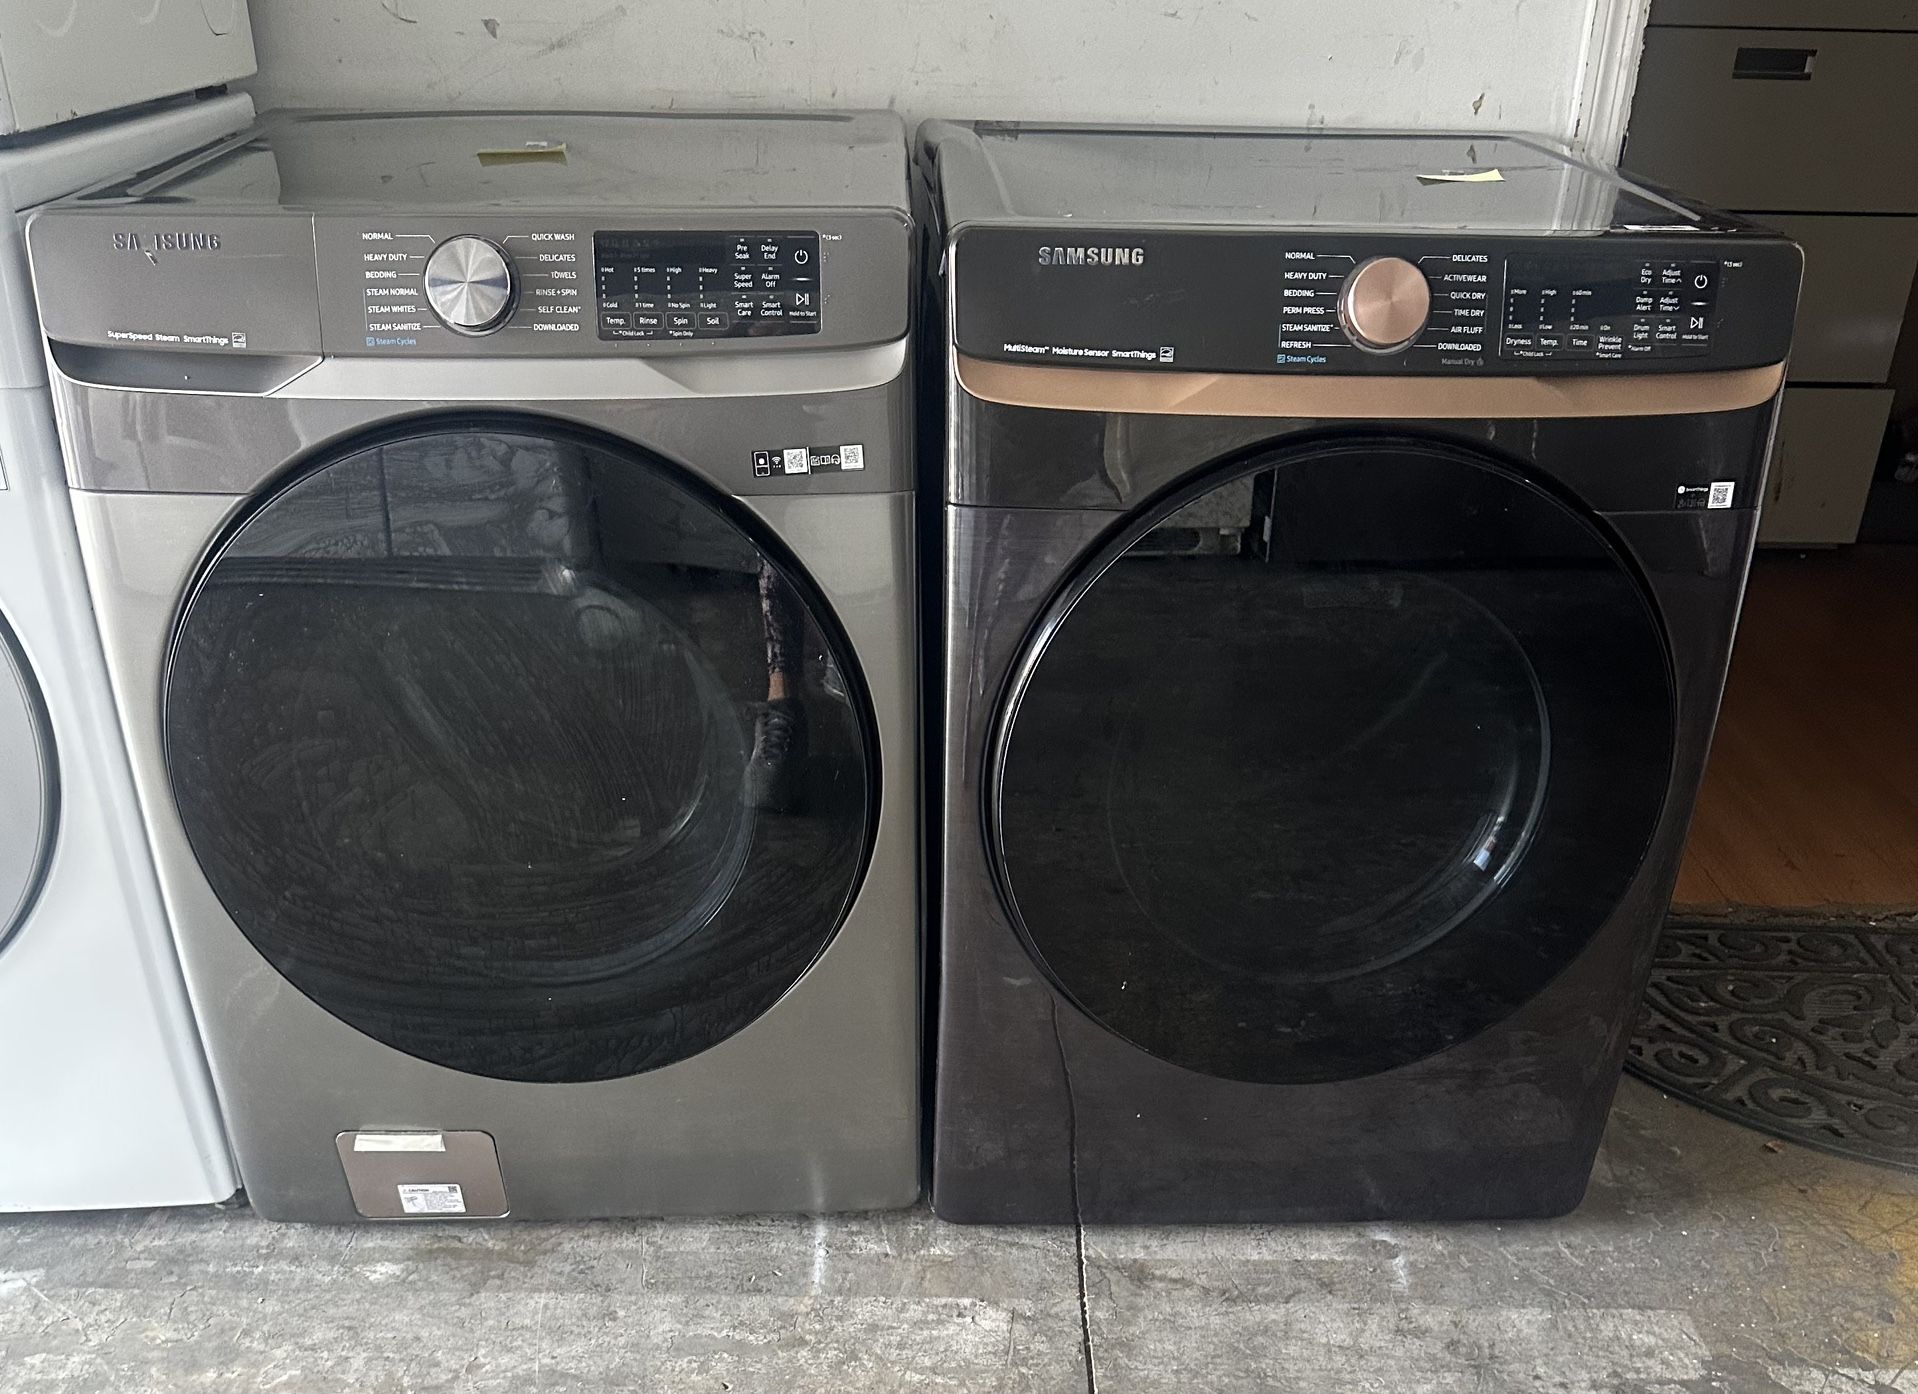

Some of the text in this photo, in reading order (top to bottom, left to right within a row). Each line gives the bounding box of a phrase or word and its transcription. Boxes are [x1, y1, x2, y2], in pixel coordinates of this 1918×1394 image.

[362, 232, 393, 240] NORMAL
[531, 233, 575, 242] QUICK WASH
[761, 244, 779, 253] Delay
[363, 253, 408, 261] HEAVY DUTY
[539, 254, 576, 262] DELICATES
[734, 252, 750, 260] Soak
[763, 252, 776, 260] End
[1037, 246, 1145, 266] SAMSUNG
[1284, 252, 1315, 260] NORMAL
[1452, 254, 1489, 263] DELICATES
[669, 266, 682, 274] High
[702, 266, 718, 274] Heavy
[1641, 268, 1653, 276] Eco
[1662, 269, 1681, 277] Adjust
[365, 271, 397, 279] BEDDING
[550, 271, 577, 279] TOWELS
[734, 272, 752, 281] Super
[1284, 271, 1328, 280] HEAVY DUTY
[1443, 274, 1487, 282] ACTIVEWEAR
[765, 280, 776, 288] Off
[1640, 276, 1652, 284] Dry
[1661, 276, 1676, 284] Time
[733, 280, 753, 289] Speed
[366, 288, 418, 296] STEAM NORMAL
[535, 288, 556, 296] RINSE
[561, 288, 578, 296] SPIN
[1283, 289, 1315, 297] BEDDING
[1450, 291, 1486, 300] QUICK DRY
[1635, 296, 1653, 304] Damp
[1660, 296, 1679, 304] Adjust
[367, 305, 416, 313] STEAM WHITES
[537, 305, 554, 313] SELF
[1282, 306, 1325, 315] PERM PRESS
[1454, 308, 1485, 317] TIME DRY
[606, 316, 626, 325] Temp.
[639, 316, 658, 325] Rinse
[673, 316, 688, 326] Spin
[706, 317, 720, 325] Soil
[369, 322, 422, 332] STEAM SANITIZE
[533, 323, 580, 332] DOWNLOADED
[1281, 323, 1303, 332] STEAM
[1450, 326, 1483, 334] AIR FLUFF
[1658, 324, 1676, 332] Smart
[107, 330, 229, 346] SuperSpeed Steam SmartThings
[1633, 332, 1648, 340] Light
[375, 337, 417, 346] Steam Cycles
[1281, 340, 1312, 349] REFRESH
[1505, 337, 1532, 346] Dryness
[1540, 338, 1559, 347] Temp.
[1572, 338, 1588, 346] Time
[1437, 342, 1482, 351] DOWNLOADED
[1598, 343, 1622, 351] Prevent
[1052, 346, 1084, 356] Moisture
[1083, 348, 1110, 357] Sensor
[1111, 350, 1157, 360] SmartThings
[1286, 355, 1327, 364] Steam Cycles
[1441, 357, 1475, 367] Manual Dry
